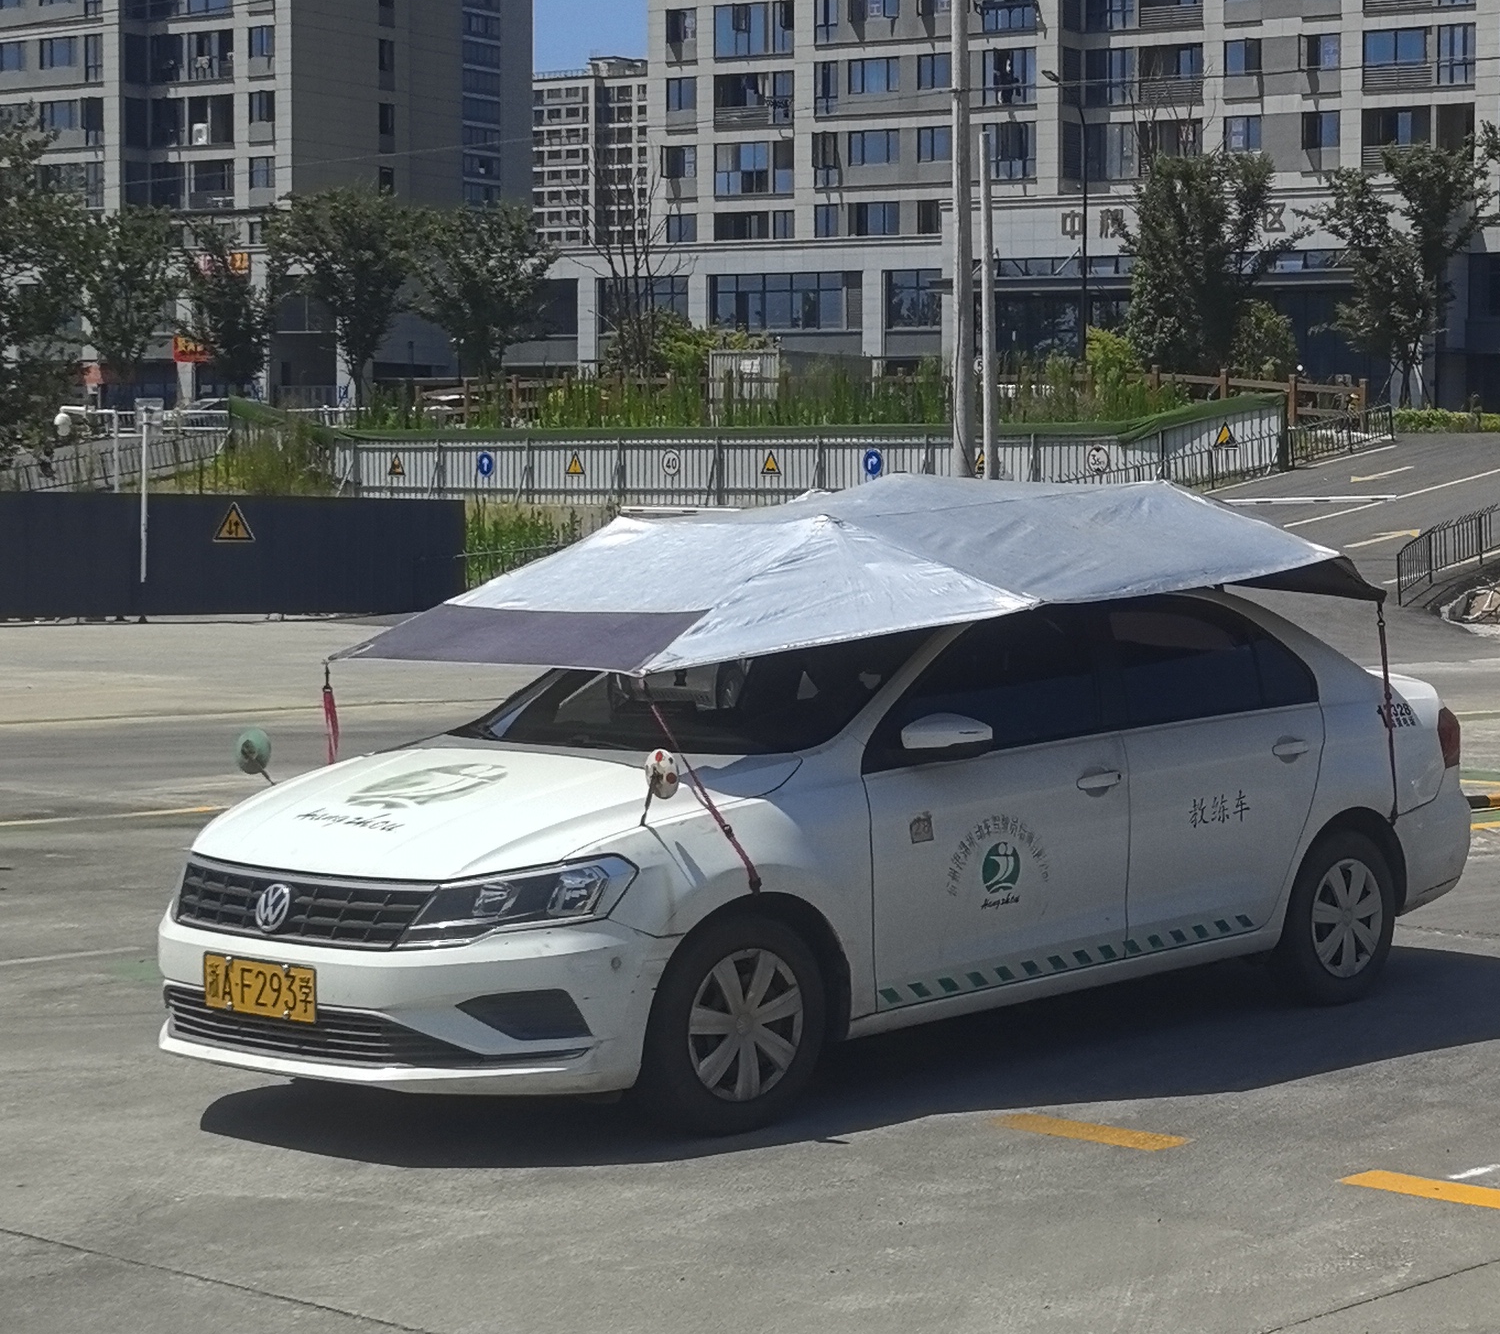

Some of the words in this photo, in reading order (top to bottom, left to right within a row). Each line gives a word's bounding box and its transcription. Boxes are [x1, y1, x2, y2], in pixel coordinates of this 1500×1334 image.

[666, 457, 677, 470] 40
[1188, 789, 1251, 828] 教练车
